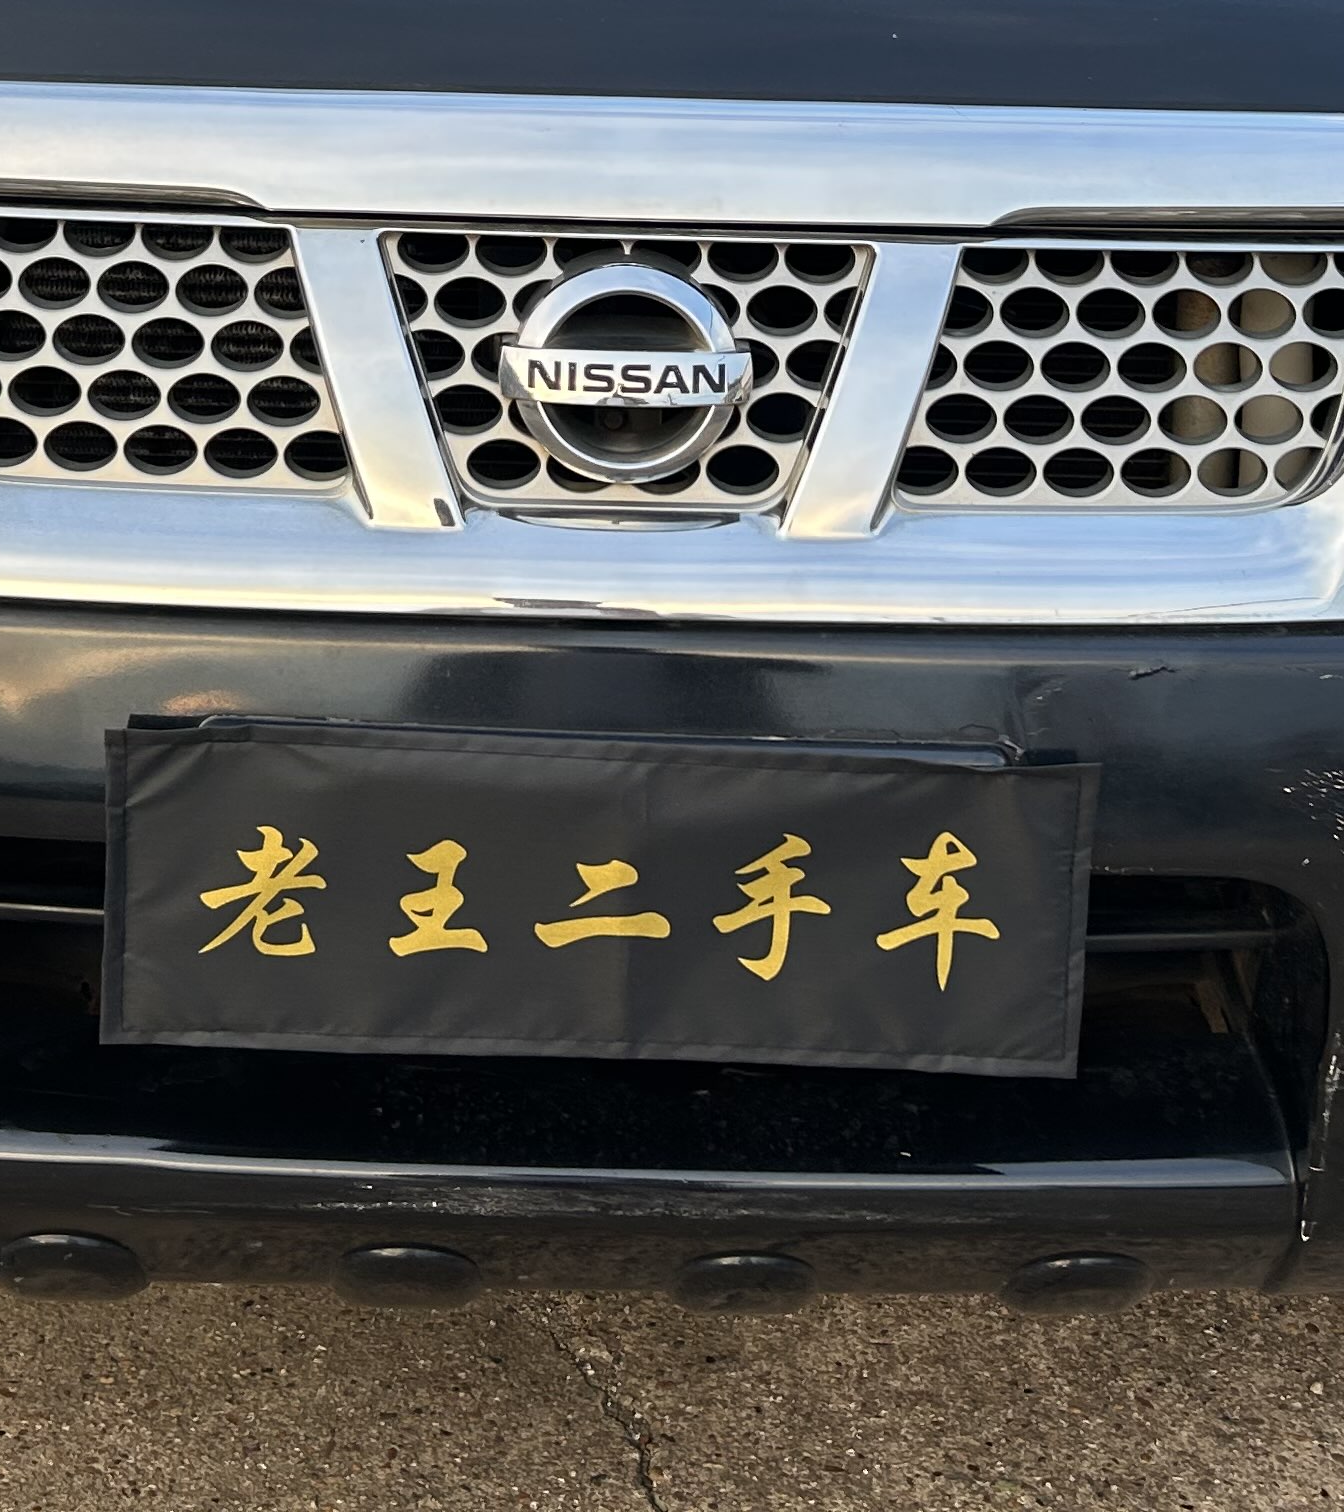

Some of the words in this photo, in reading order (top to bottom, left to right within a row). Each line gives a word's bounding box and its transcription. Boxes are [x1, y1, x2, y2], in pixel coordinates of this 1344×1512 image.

[526, 358, 727, 395] NISSAN
[196, 824, 1002, 992] 老王二手车
